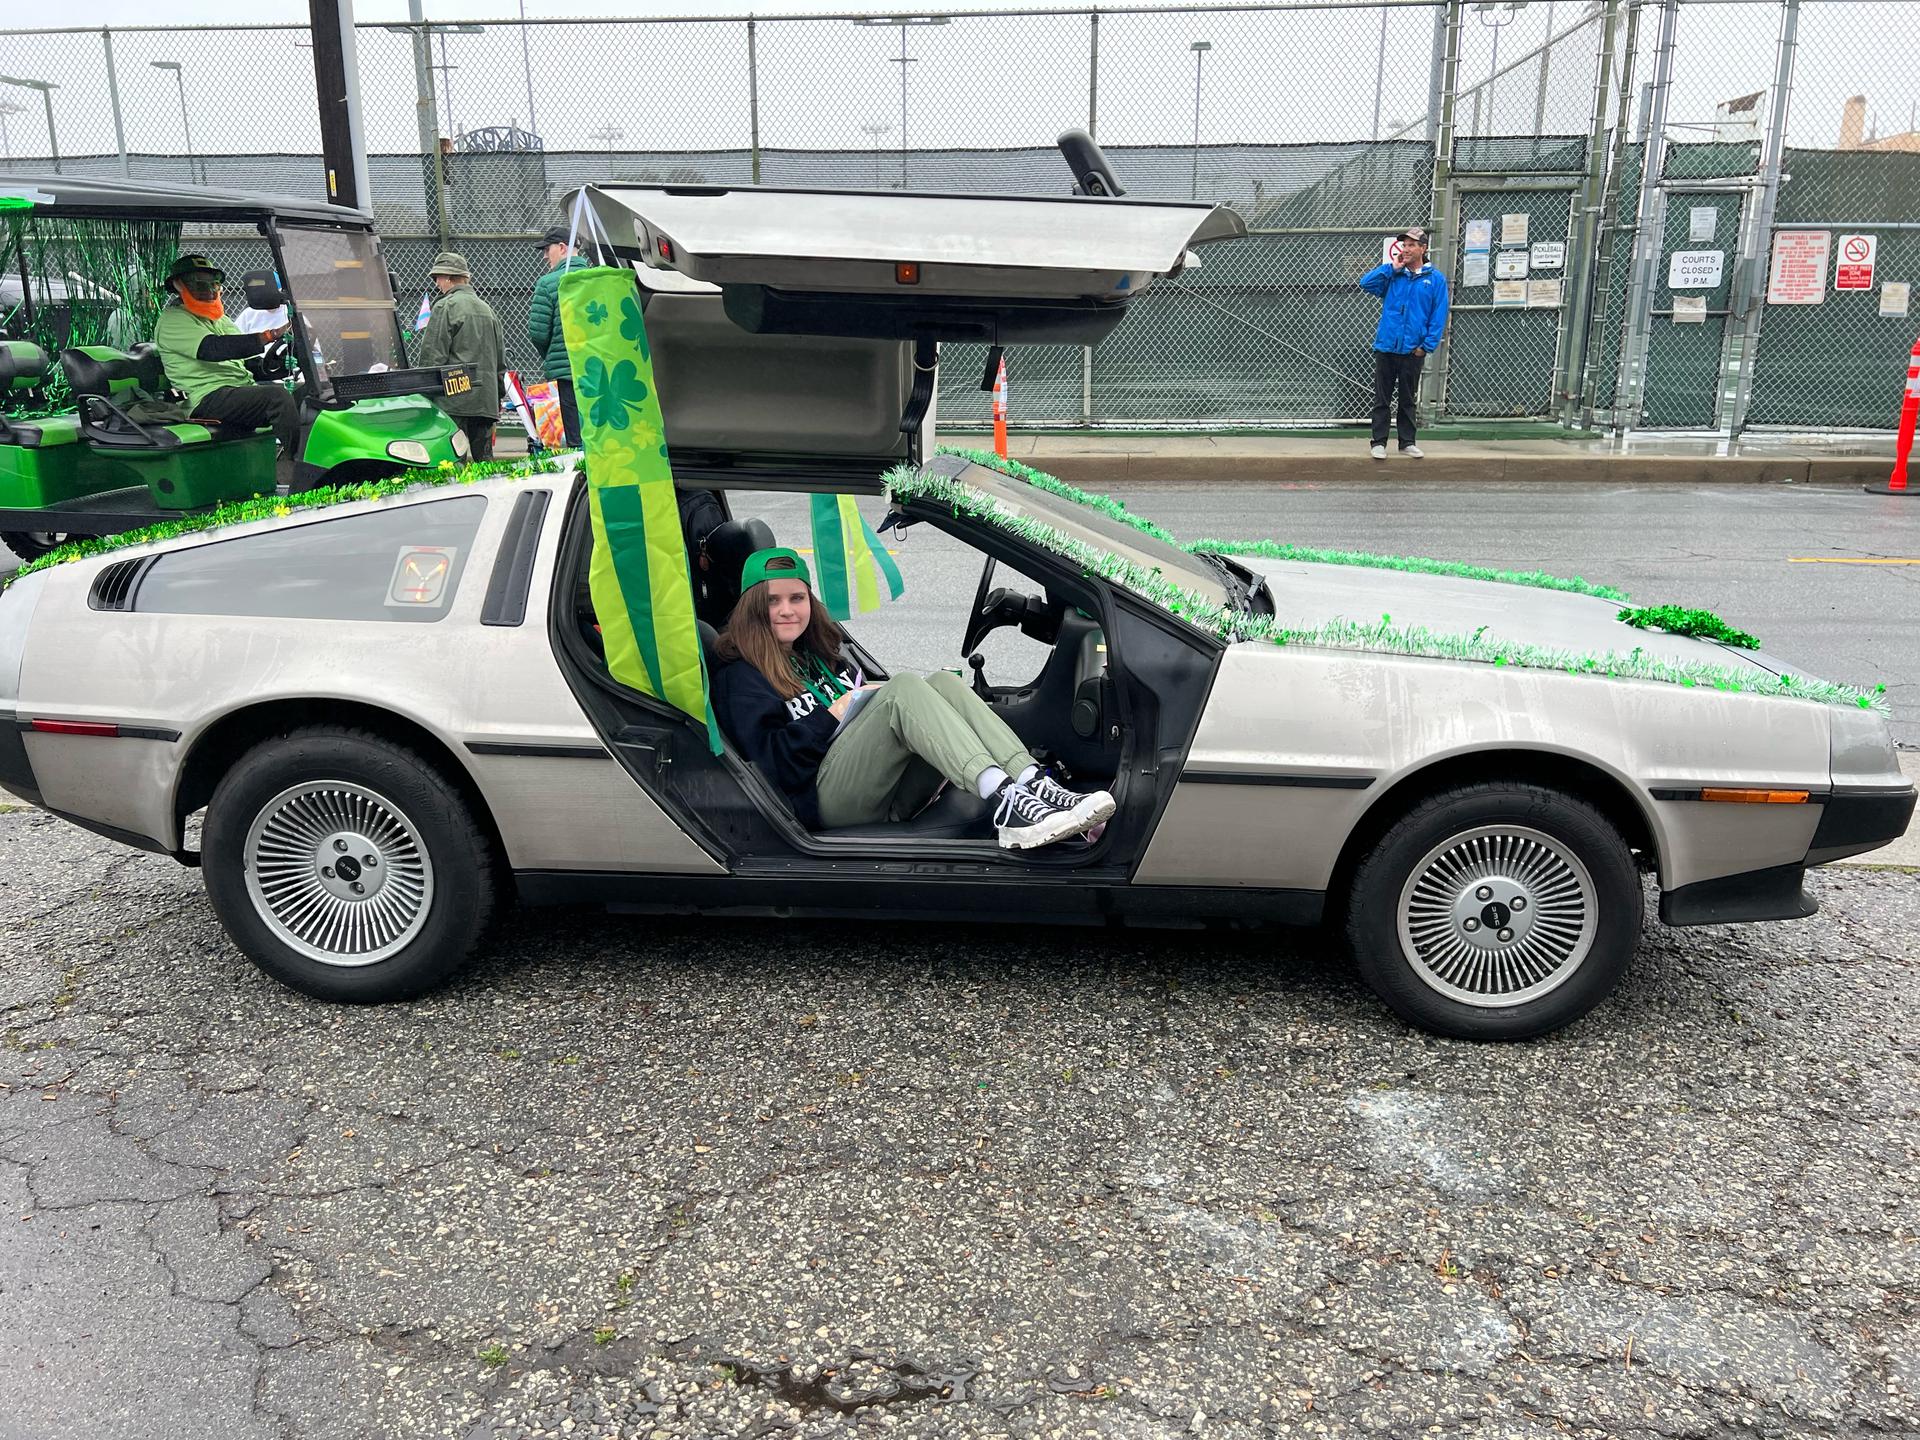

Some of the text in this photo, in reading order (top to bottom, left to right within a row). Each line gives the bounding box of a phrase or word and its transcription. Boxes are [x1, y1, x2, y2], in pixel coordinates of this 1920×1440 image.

[1533, 245, 1562, 253] PICKLEBALL
[1682, 256, 1716, 264] COURTS
[1681, 266, 1714, 274] CLOSED
[1684, 277, 1690, 285] 9
